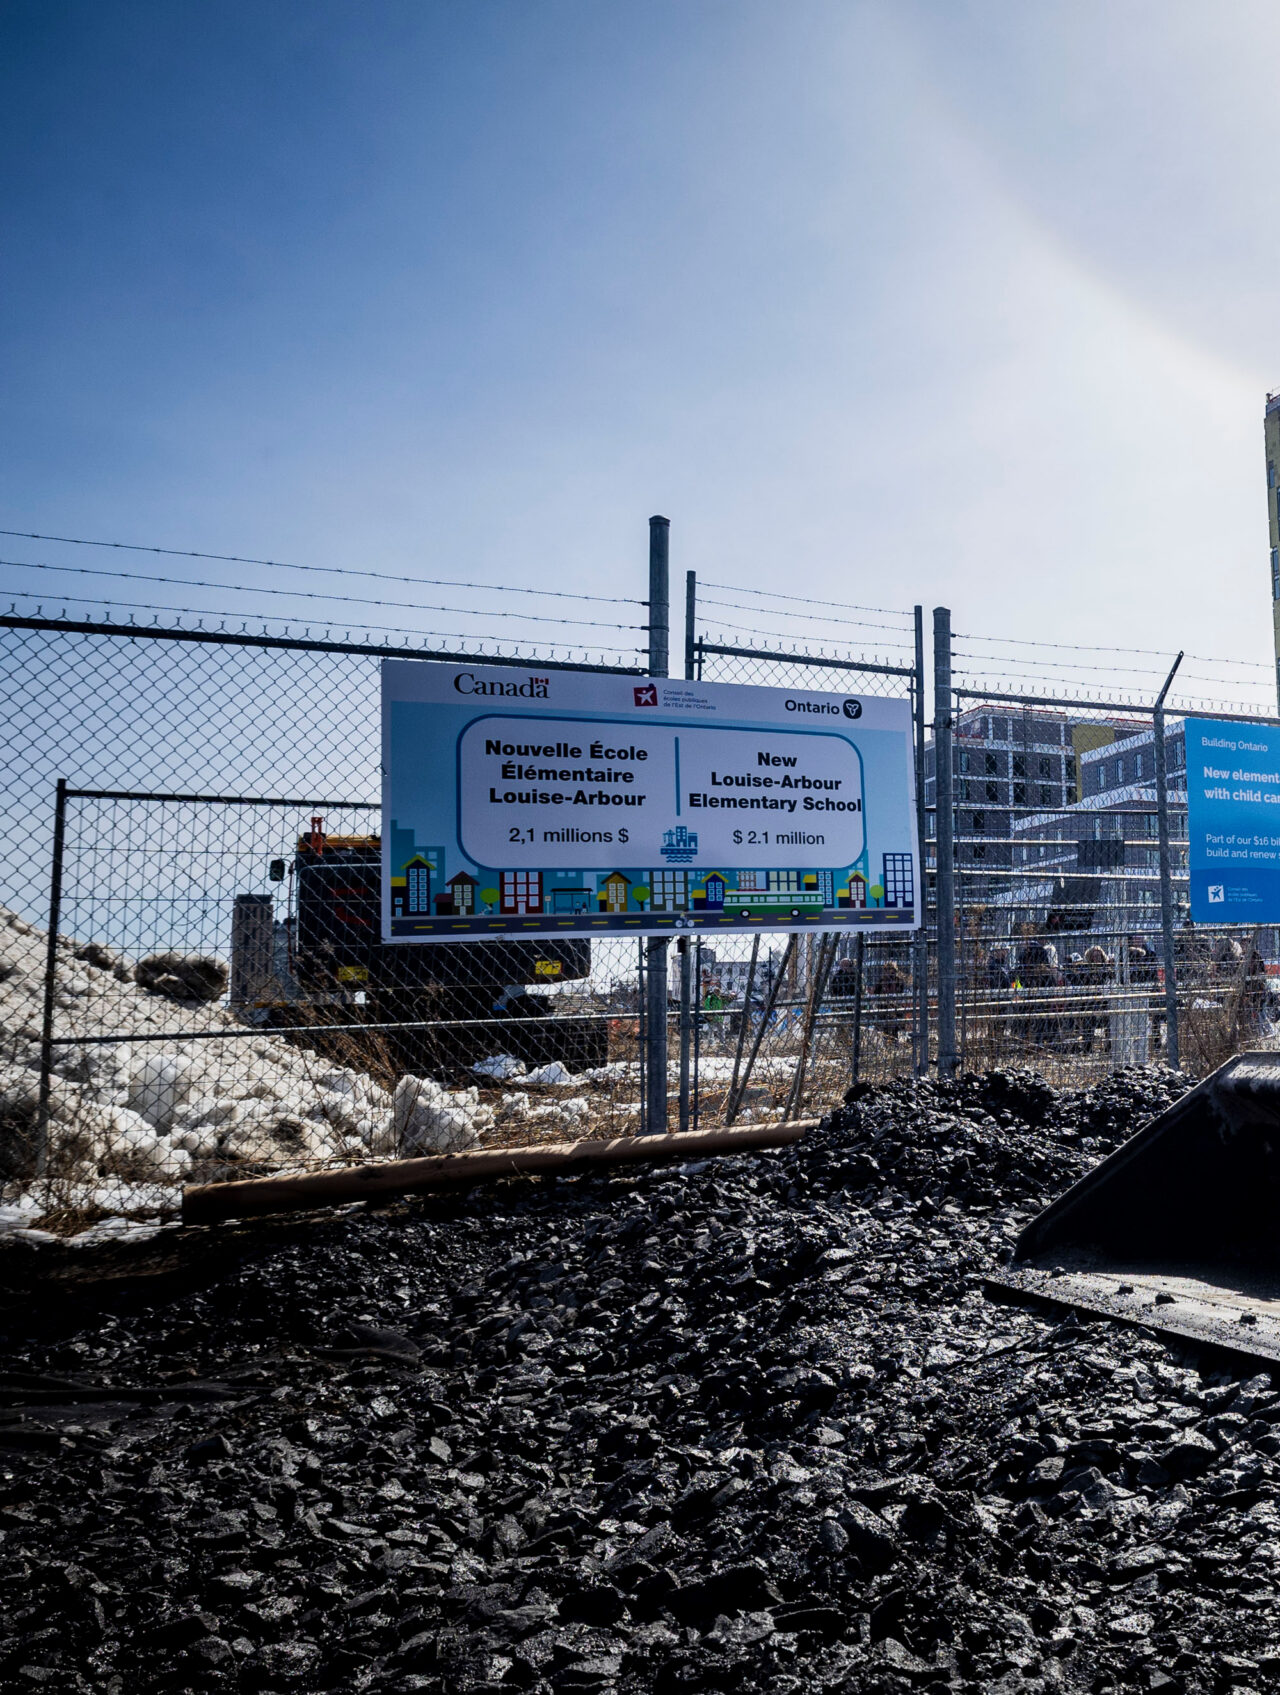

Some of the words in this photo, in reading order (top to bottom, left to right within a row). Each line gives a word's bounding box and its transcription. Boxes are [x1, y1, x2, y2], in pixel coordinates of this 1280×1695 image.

[454, 672, 550, 699] Canada
[784, 699, 840, 715] Ontario
[485, 739, 583, 759] Nouvelle
[589, 740, 649, 761] École
[1201, 736, 1237, 751] Building
[1238, 740, 1269, 753] Ontario
[757, 752, 798, 768] New
[501, 760, 635, 783] Élémentaire
[1203, 766, 1231, 780] New
[711, 772, 842, 791] Louise-Arbour
[489, 787, 647, 806] Louise-Arbour
[688, 793, 797, 813] Elementary
[803, 796, 862, 812] School
[1204, 787, 1231, 801] with
[1232, 789, 1262, 803] child
[508, 827, 535, 845] 2,1
[543, 828, 613, 843] millions
[617, 827, 629, 844] $
[732, 829, 743, 845] $
[747, 830, 769, 845] 2.1
[776, 831, 825, 845] million
[1205, 833, 1225, 845] Part
[1226, 835, 1235, 845] of
[1236, 837, 1252, 846] our
[1253, 835, 1269, 847] $16
[1206, 847, 1230, 858] build
[1231, 848, 1248, 859] and
[1249, 850, 1277, 860] renew
